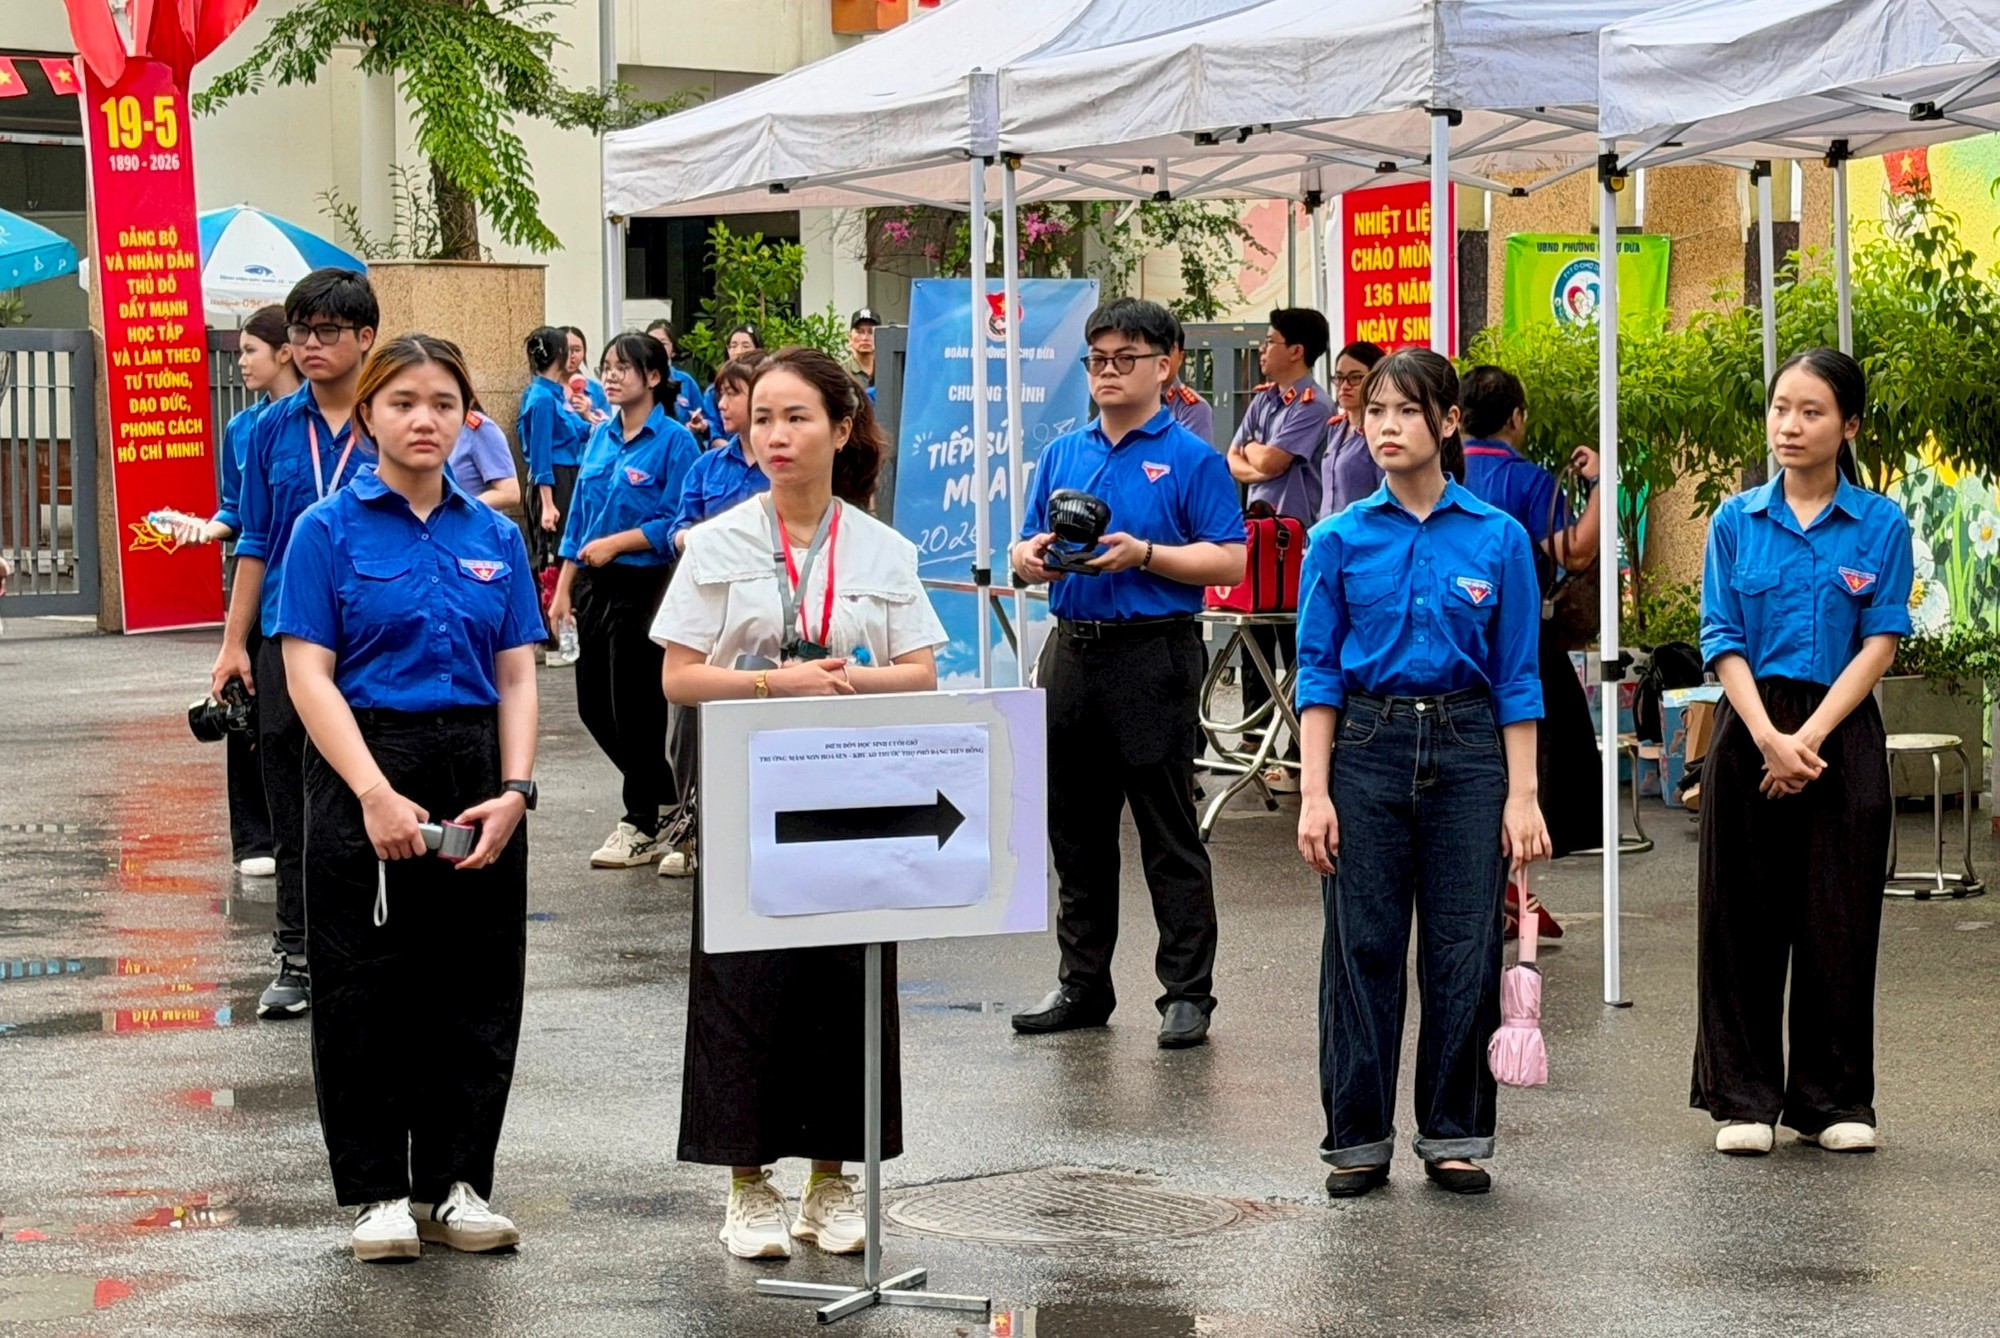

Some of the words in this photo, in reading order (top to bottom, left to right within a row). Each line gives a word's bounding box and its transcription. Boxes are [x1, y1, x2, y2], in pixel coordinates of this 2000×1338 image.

[101, 95, 178, 149] 19-5
[109, 154, 140, 172] 1890
[149, 153, 180, 171] 2026
[1354, 204, 1401, 239] NHIỆT
[1405, 201, 1431, 237] LIỆ
[118, 225, 156, 248] ĐẢNG
[158, 225, 178, 249] BỘ
[1537, 242, 1559, 253] UBND
[105, 251, 125, 272] VÀ
[127, 250, 164, 271] NHÂN
[166, 249, 195, 270] DÂN
[1351, 241, 1395, 272] CHÀO
[1398, 238, 1432, 269] MỪN
[126, 272, 155, 295] THỦ
[157, 272, 178, 294] ĐÔ
[1364, 283, 1394, 308] 136
[1397, 277, 1432, 306] NĂM
[118, 295, 146, 319] ĐẨY
[149, 300, 188, 320] MẠNH
[127, 326, 155, 345] HỌC
[157, 320, 184, 344] TẬP
[1356, 312, 1399, 343] NGÀY
[1402, 316, 1431, 342] SIN
[112, 346, 132, 367] VÀ
[134, 345, 163, 366] LÀM
[165, 347, 202, 364] THEO
[124, 371, 144, 391] TƯ
[145, 366, 193, 390] TƯỞNG,
[129, 396, 158, 417] ĐẠO
[160, 391, 192, 413] ĐỨC,
[120, 420, 166, 439] PHONG
[168, 415, 203, 435] CÁCH
[117, 439, 137, 464] HỒ
[140, 439, 163, 462] CHÍ
[166, 441, 205, 459] MINH!
[927, 425, 974, 471] TIẾP
